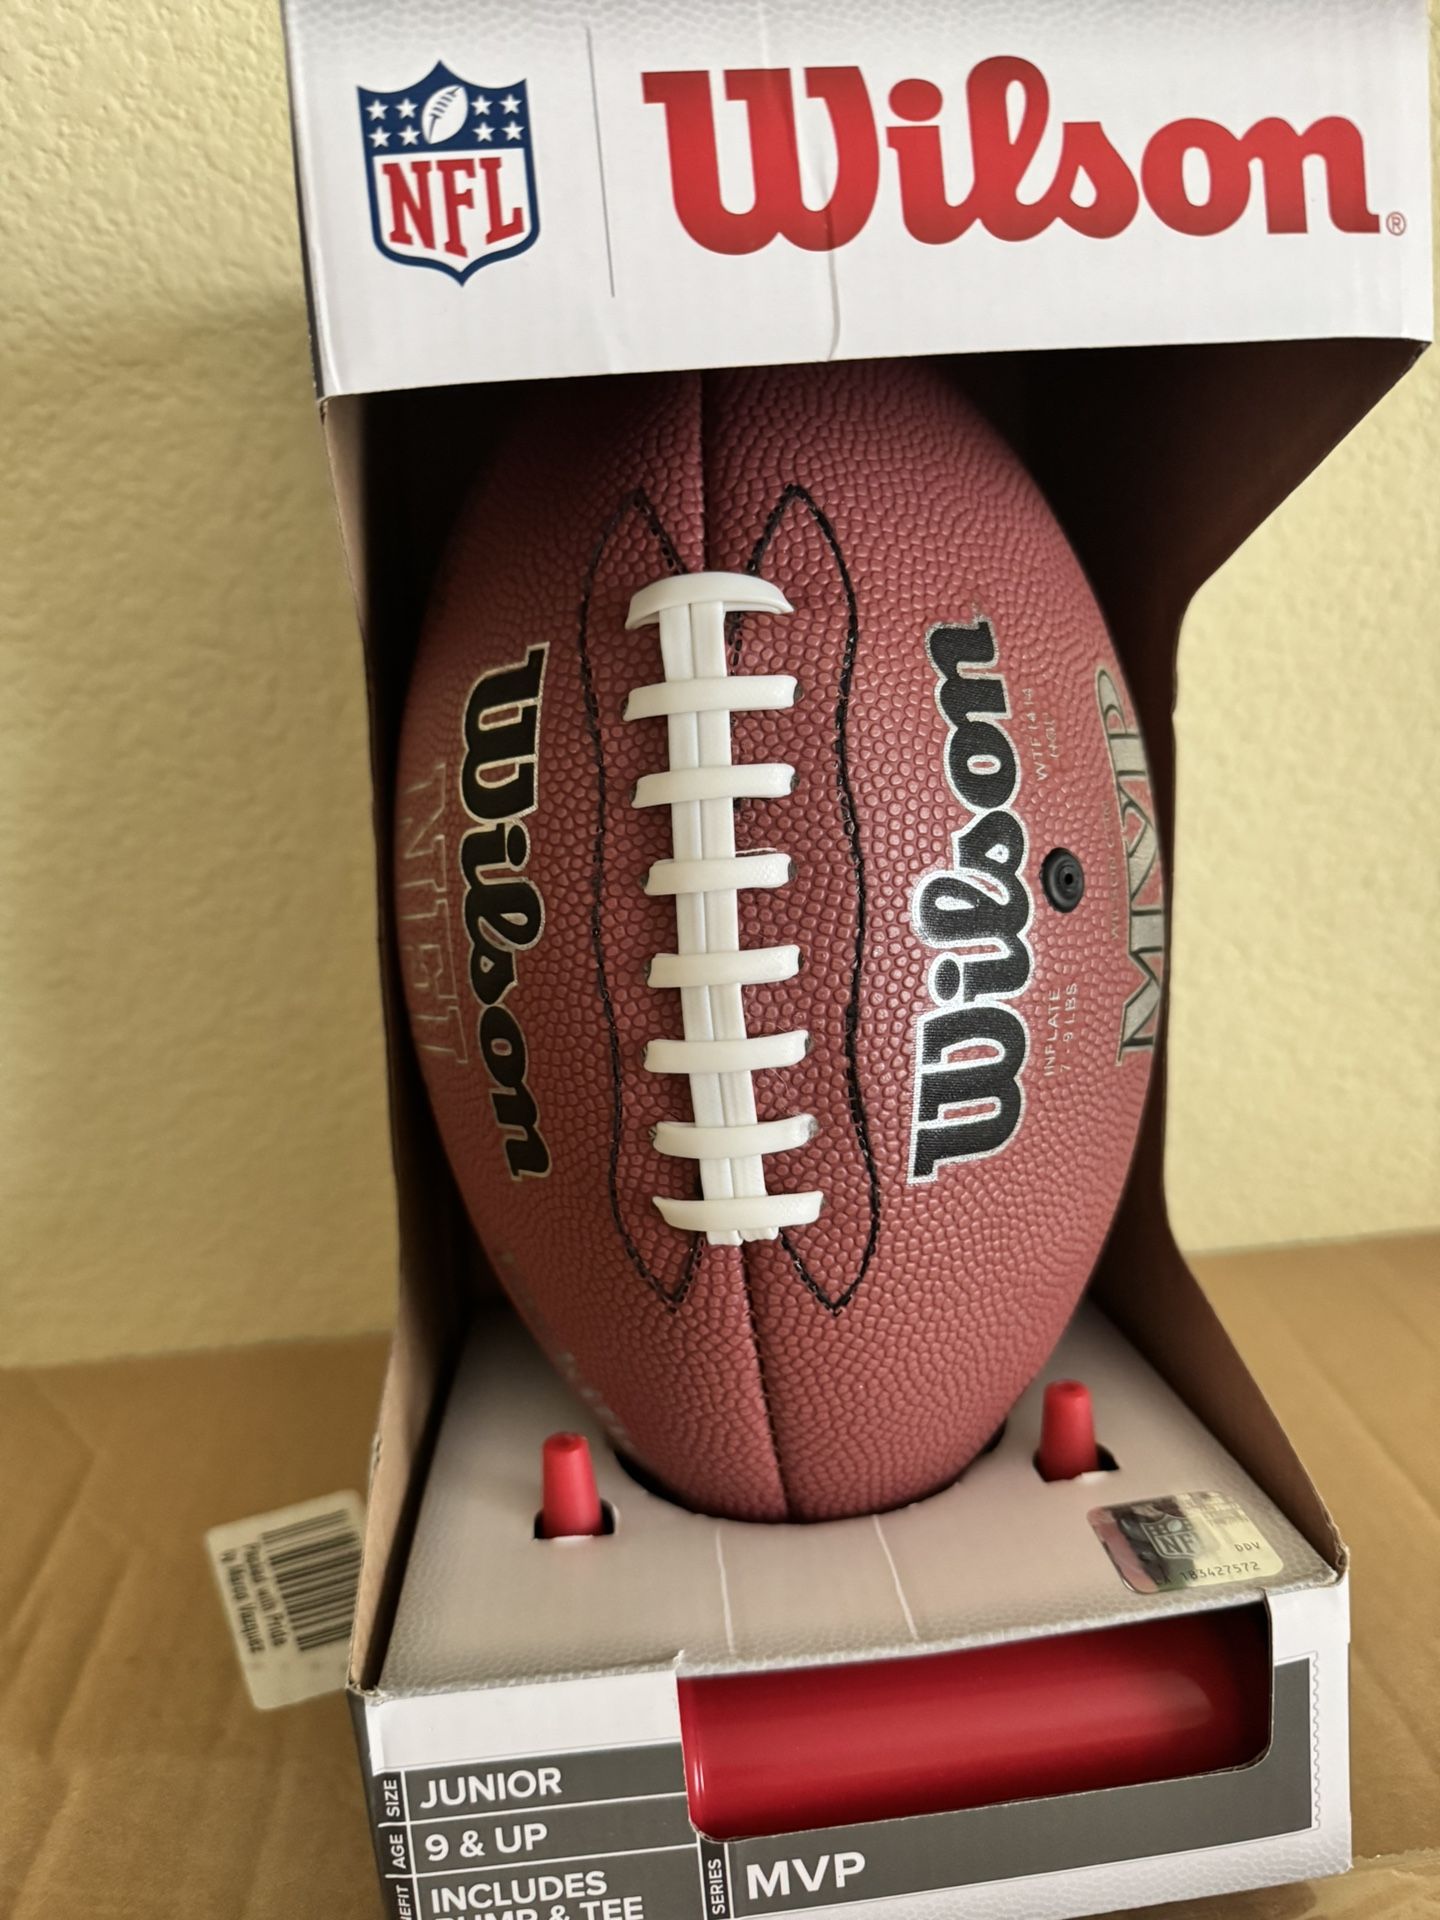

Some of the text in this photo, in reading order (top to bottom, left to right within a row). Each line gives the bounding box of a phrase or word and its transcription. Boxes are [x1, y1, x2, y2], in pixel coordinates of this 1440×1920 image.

[382, 156, 526, 259] NFL
[1095, 664, 1165, 1067] MVP
[458, 640, 552, 1182] Wilson
[907, 612, 1034, 1186] Wilson
[1064, 983, 1078, 1024] LBS
[1044, 987, 1061, 1076] INFLATE
[1062, 1031, 1074, 1042] 9
[1060, 1064, 1072, 1073] 7
[383, 1779, 401, 1817] SIZE
[419, 1767, 562, 1809] JUNIOR
[389, 1834, 407, 1869] AGE
[424, 1822, 548, 1862] 9 & UP
[430, 1870, 608, 1914] INCLUDES
[707, 1858, 725, 1914] SERIES
[746, 1851, 866, 1899] MVP
[579, 1896, 645, 1920] TEE
